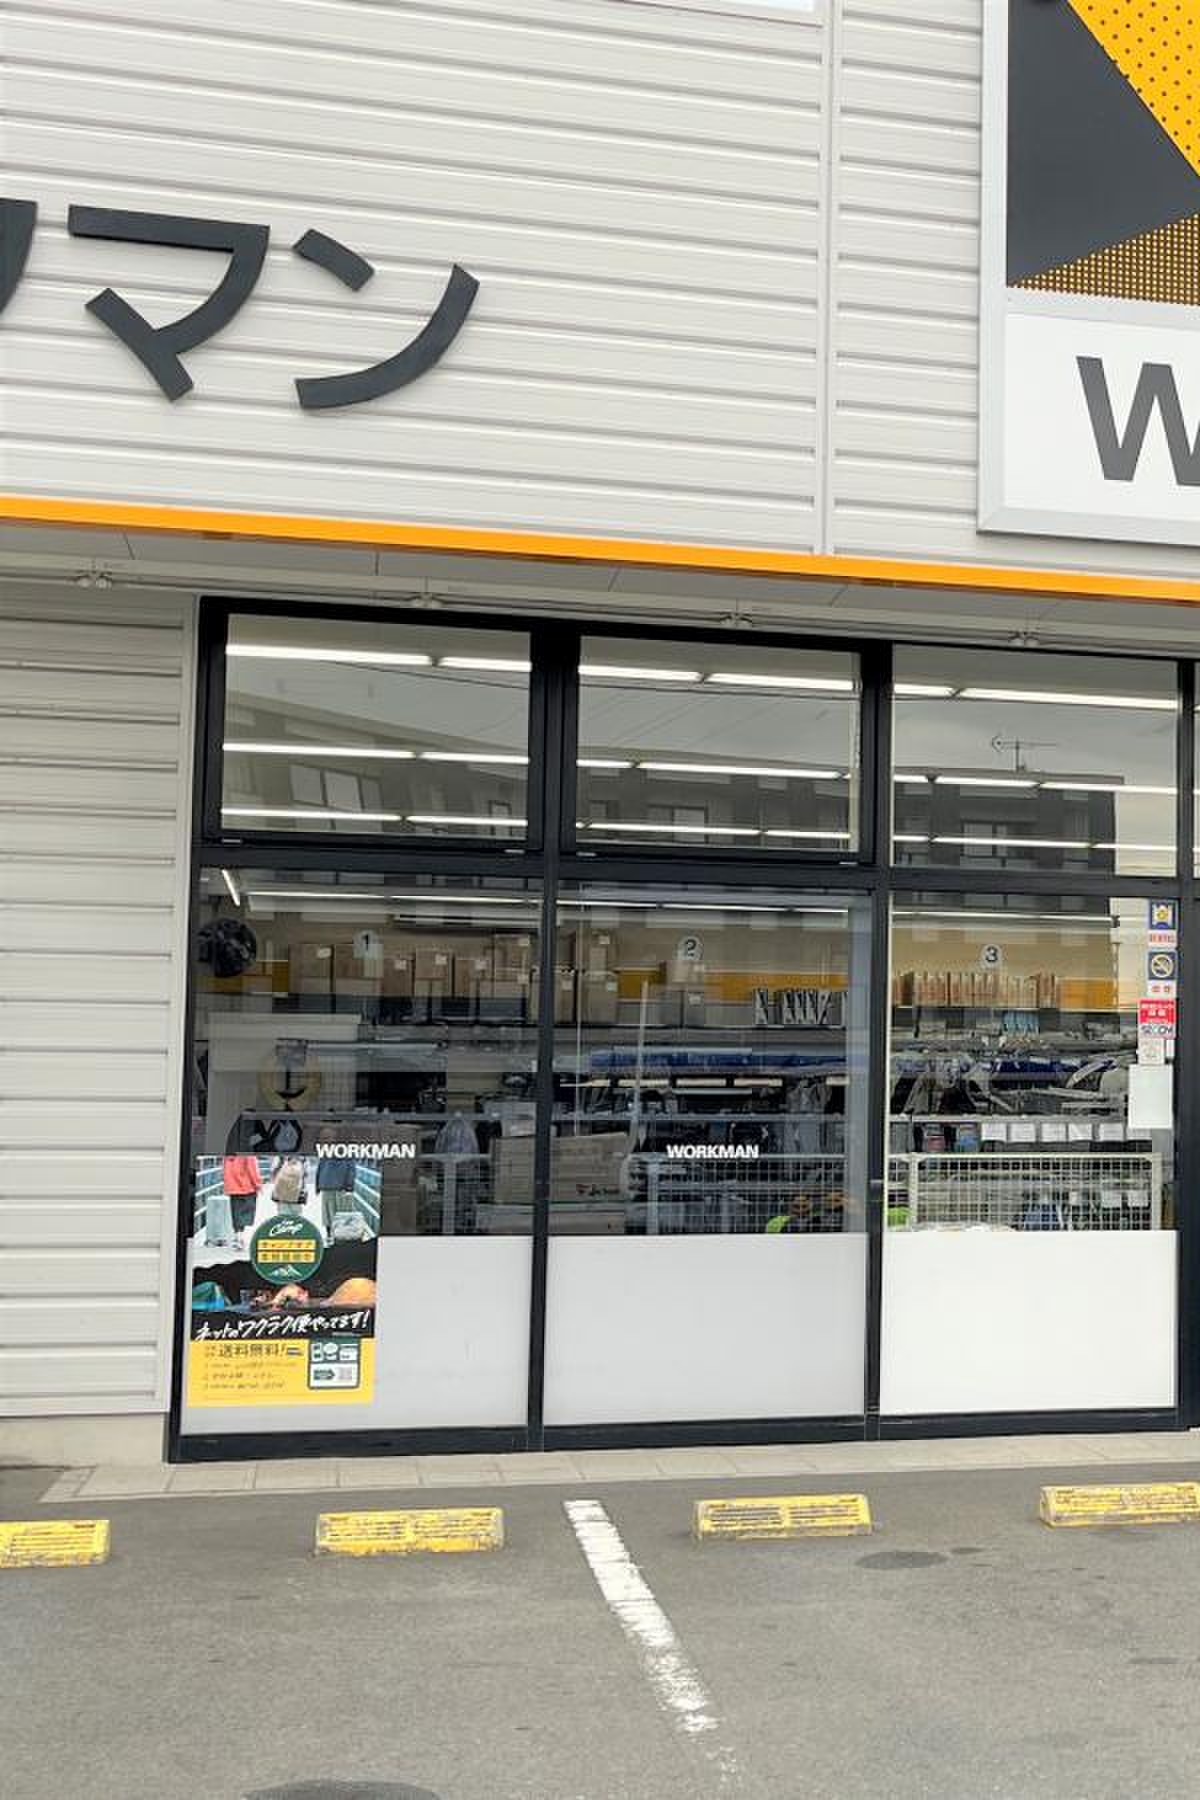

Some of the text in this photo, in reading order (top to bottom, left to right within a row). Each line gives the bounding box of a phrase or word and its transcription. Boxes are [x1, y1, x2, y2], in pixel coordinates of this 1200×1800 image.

[0, 200, 480, 410] マン
[986, 946, 998, 962] 3
[316, 1142, 416, 1160] WORKMAN
[666, 1143, 760, 1159] WORKMAN
